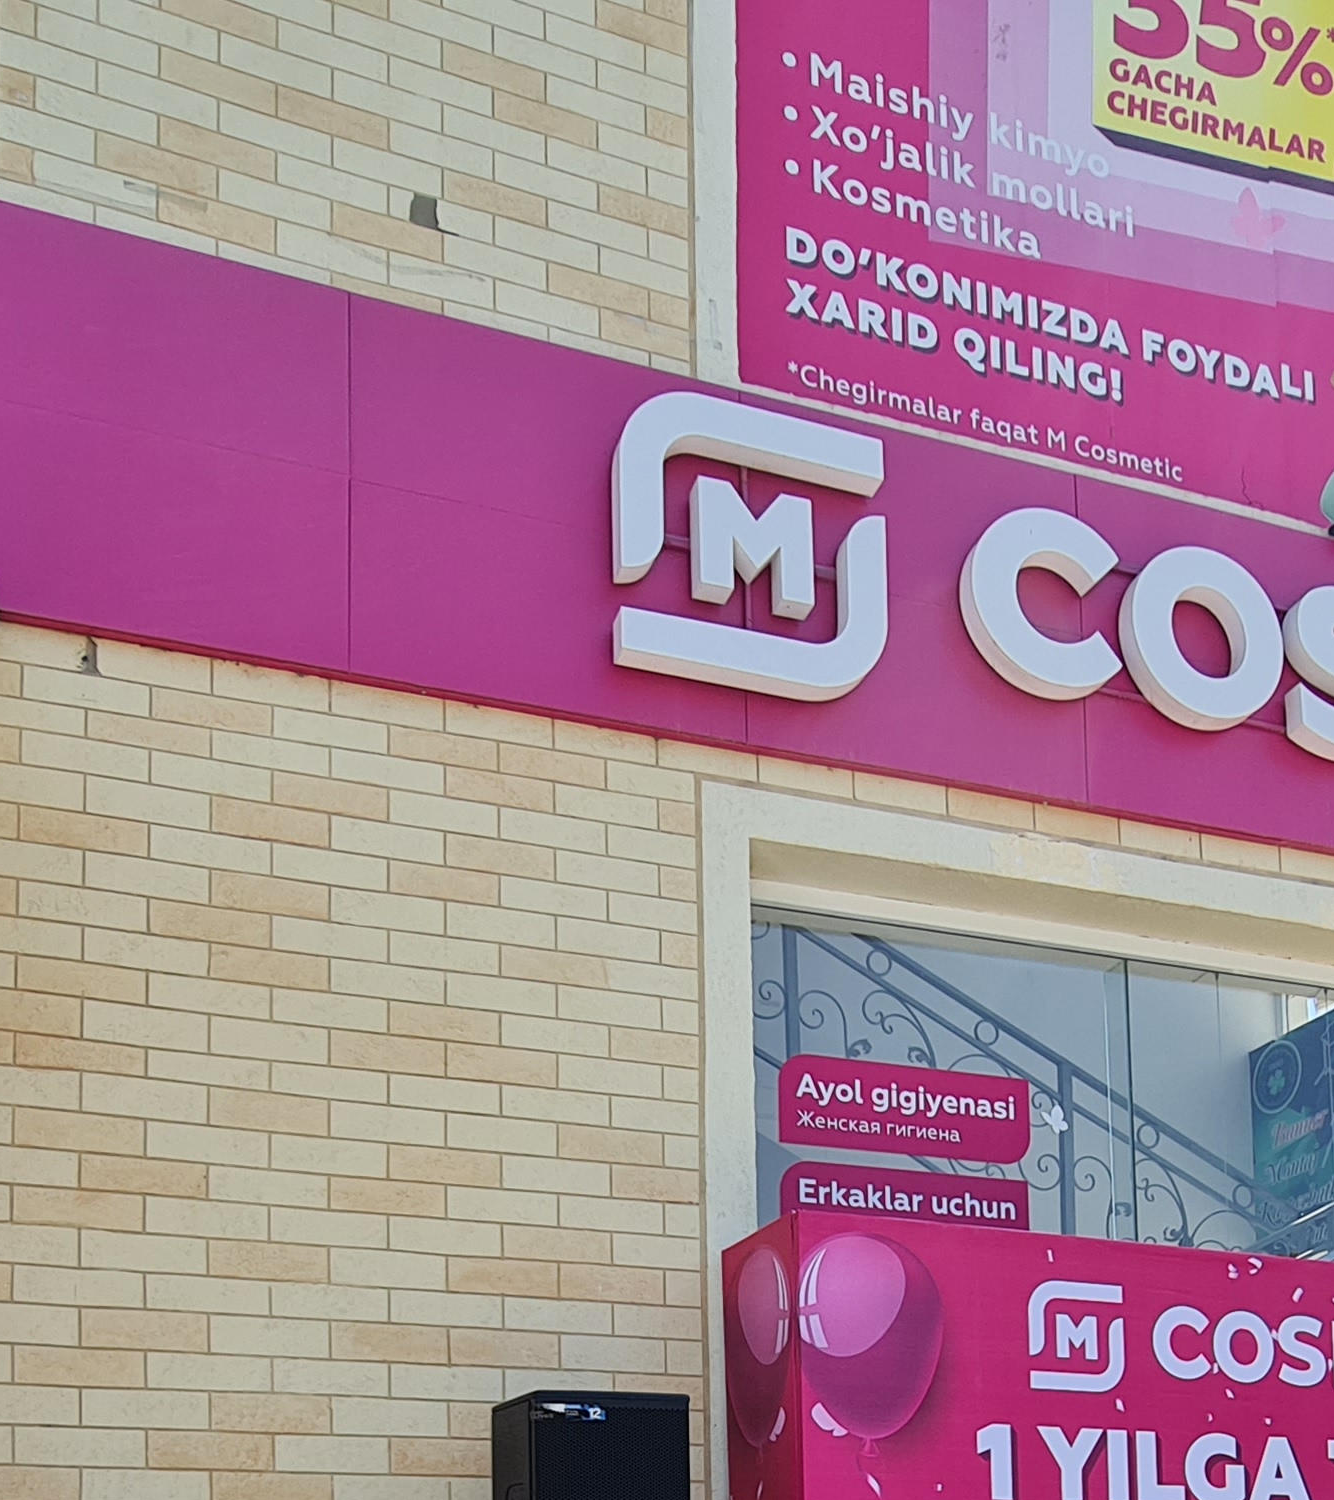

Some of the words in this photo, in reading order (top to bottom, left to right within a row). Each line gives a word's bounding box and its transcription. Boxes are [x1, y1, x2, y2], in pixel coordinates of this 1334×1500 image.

[808, 51, 974, 142] Maishiy
[989, 111, 1111, 179] kimyo
[1108, 57, 1218, 107] GACHA
[1106, 89, 1327, 164] CHEGIRMALAR
[812, 157, 1042, 260] Kosmetika
[991, 168, 1136, 239] mollari
[785, 278, 940, 351] XARID
[953, 327, 1125, 404] QILING!
[1142, 328, 1317, 403] FOYDALI
[969, 408, 1040, 451] faqat
[1047, 426, 1067, 452] M
[1074, 434, 1184, 483] Cosmetic
[795, 1072, 864, 1106] Ayol
[870, 1083, 1016, 1121] gigiyenasi
[796, 1109, 882, 1135] Женская
[886, 1122, 962, 1144] гигиена
[798, 1177, 925, 1213] Erkaklar
[931, 1192, 1017, 1221] uchun
